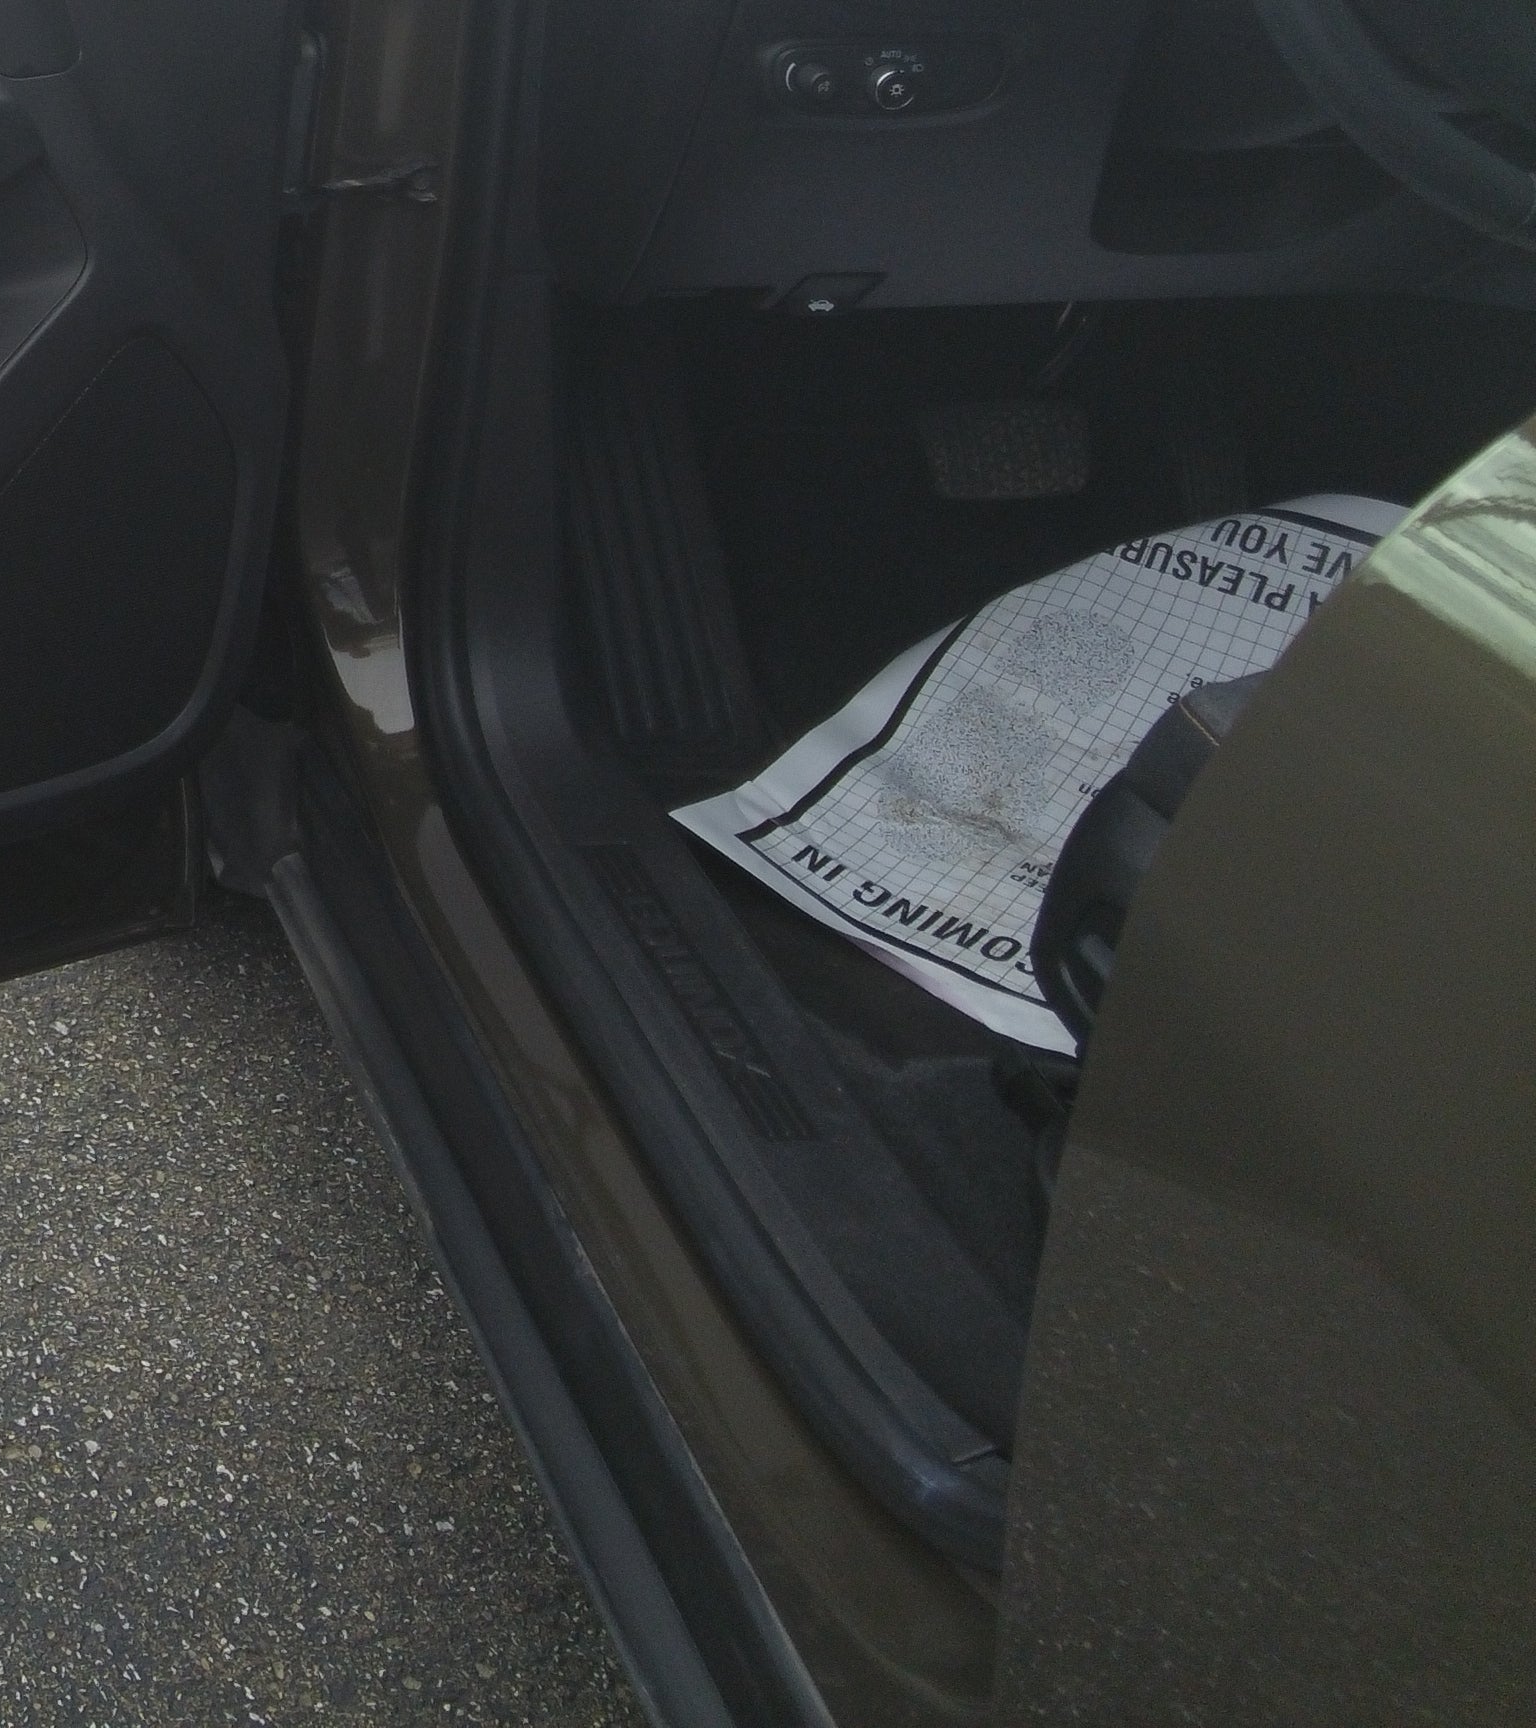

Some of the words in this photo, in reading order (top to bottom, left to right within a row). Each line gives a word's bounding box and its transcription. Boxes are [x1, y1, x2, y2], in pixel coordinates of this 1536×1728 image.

[880, 49, 903, 59] AUTO
[1211, 519, 1289, 565] YOU
[1104, 537, 1296, 612] PLEASUR
[790, 844, 847, 882] IN
